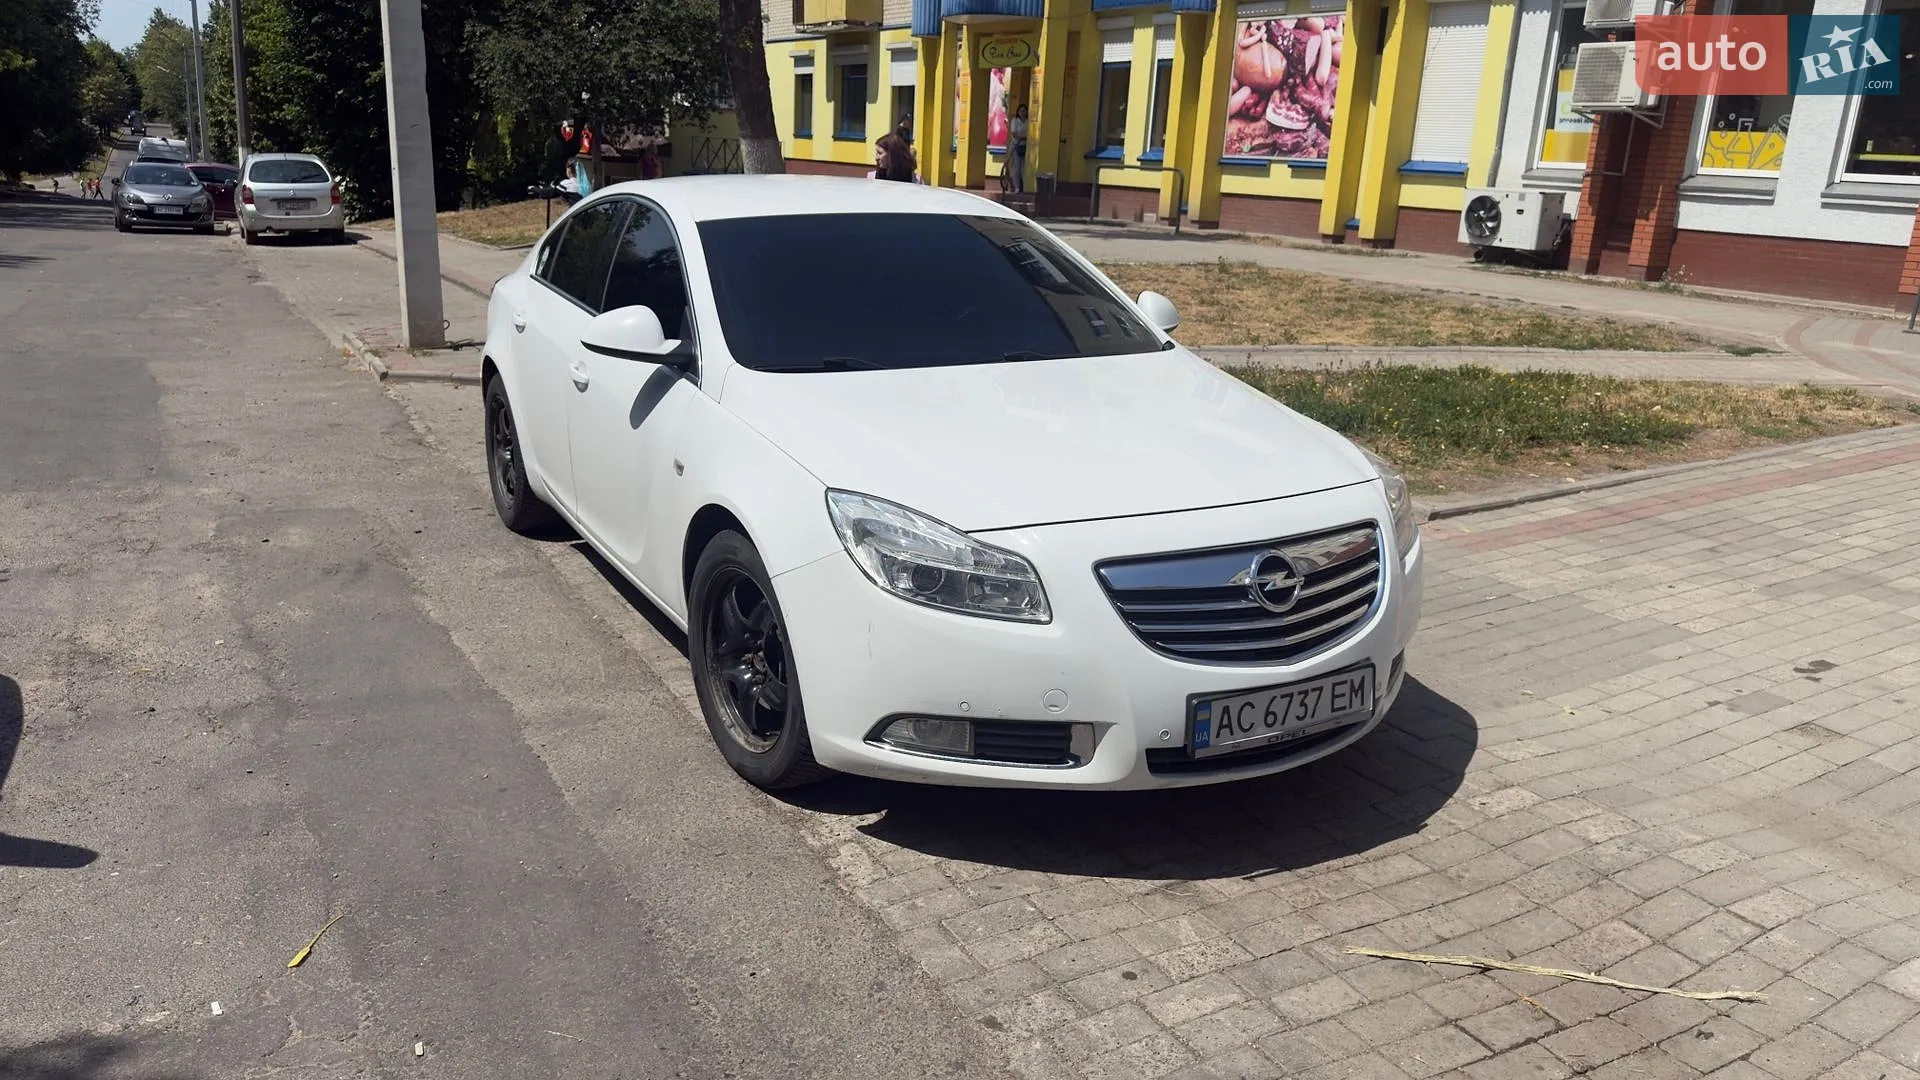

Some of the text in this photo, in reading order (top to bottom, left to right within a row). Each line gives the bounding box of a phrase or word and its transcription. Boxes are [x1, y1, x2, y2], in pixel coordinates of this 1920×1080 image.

[1215, 675, 1366, 738] AC 6737 EM
[1195, 732, 1210, 743] UA
[1267, 728, 1307, 743] OPEL
